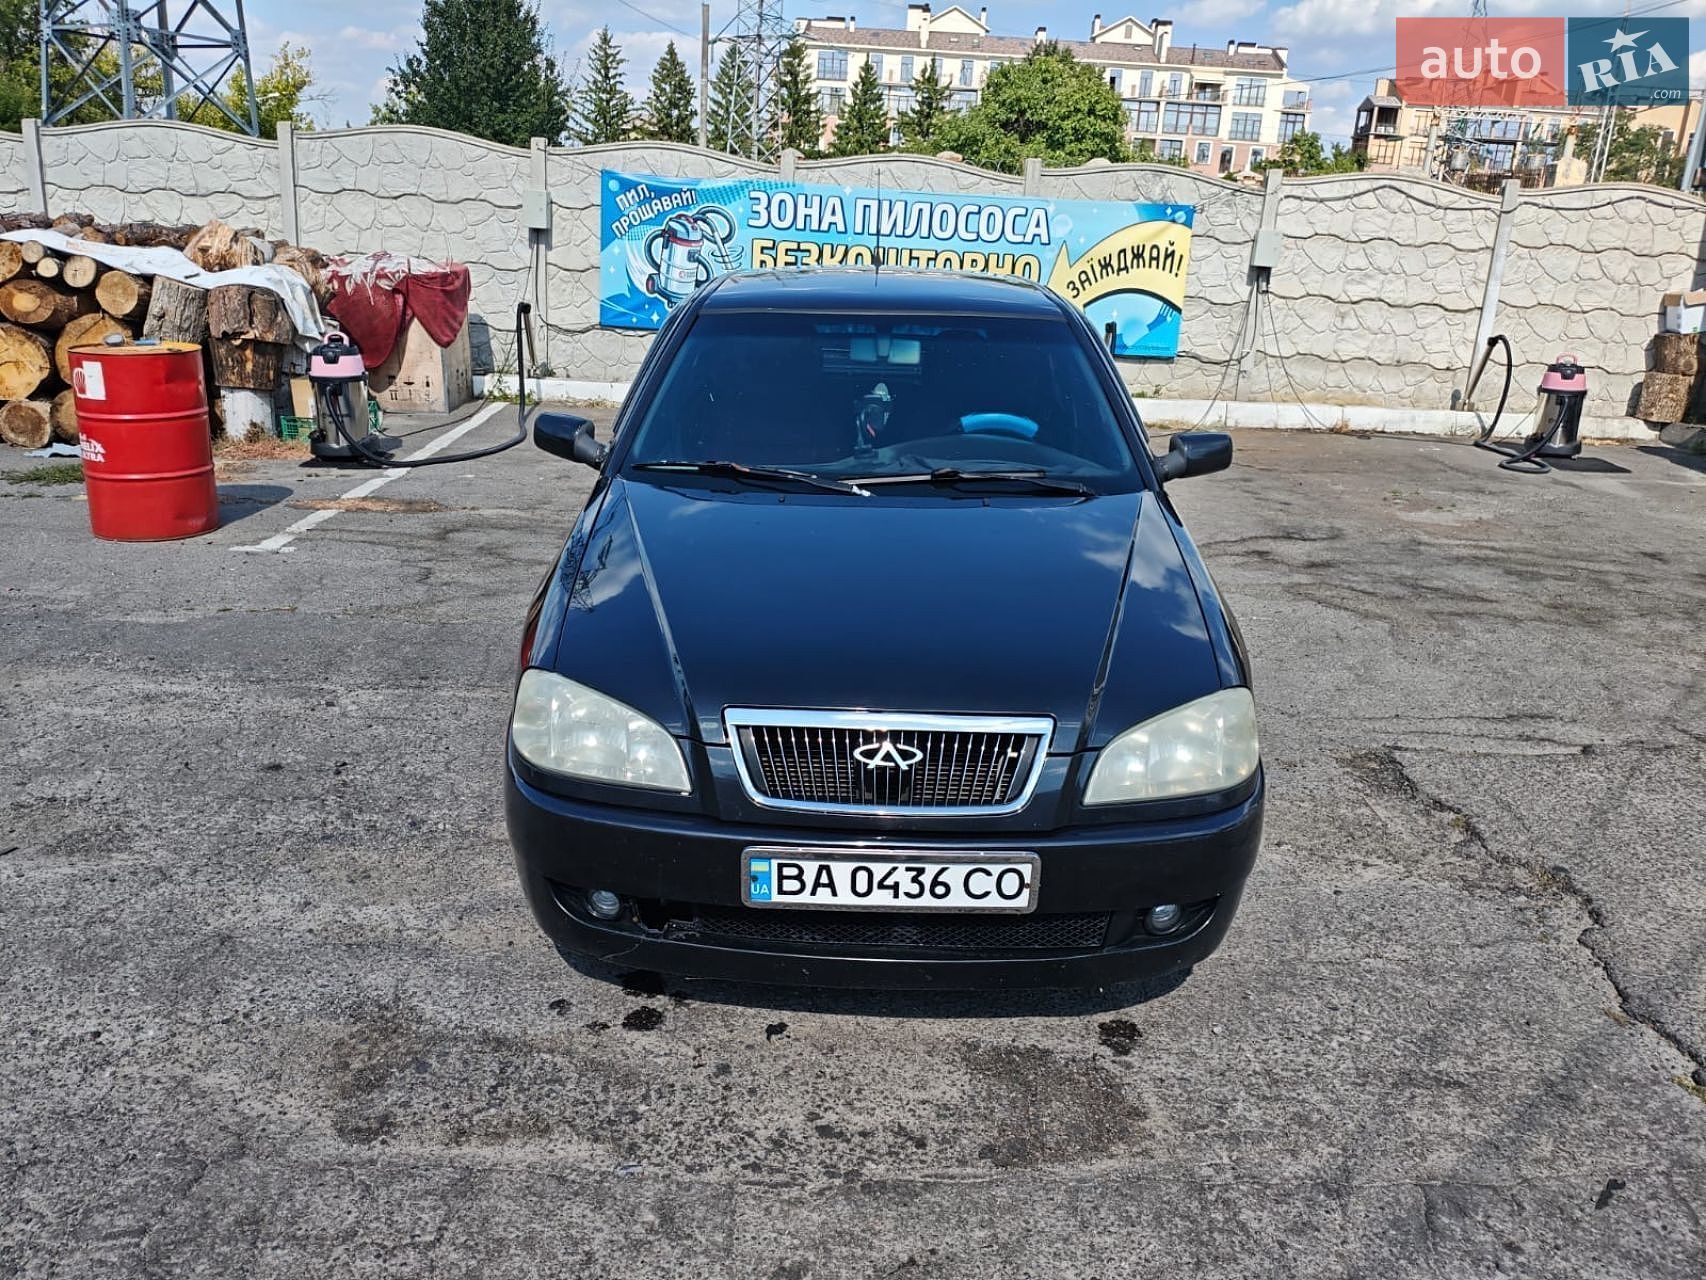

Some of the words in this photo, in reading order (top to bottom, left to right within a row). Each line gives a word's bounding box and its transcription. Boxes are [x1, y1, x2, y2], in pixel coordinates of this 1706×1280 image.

[611, 188, 698, 239] ПРОЩАВАЙ!
[615, 183, 656, 211] ПИЛ,
[747, 189, 848, 234] ЗОНА
[853, 197, 1051, 246] ПИЛОСОСА
[1066, 240, 1184, 299] ЗАЇЖДЖАЙ!
[751, 883, 770, 895] UA
[776, 862, 838, 897] BA
[850, 865, 951, 899] 0436
[963, 867, 1026, 901] CO
